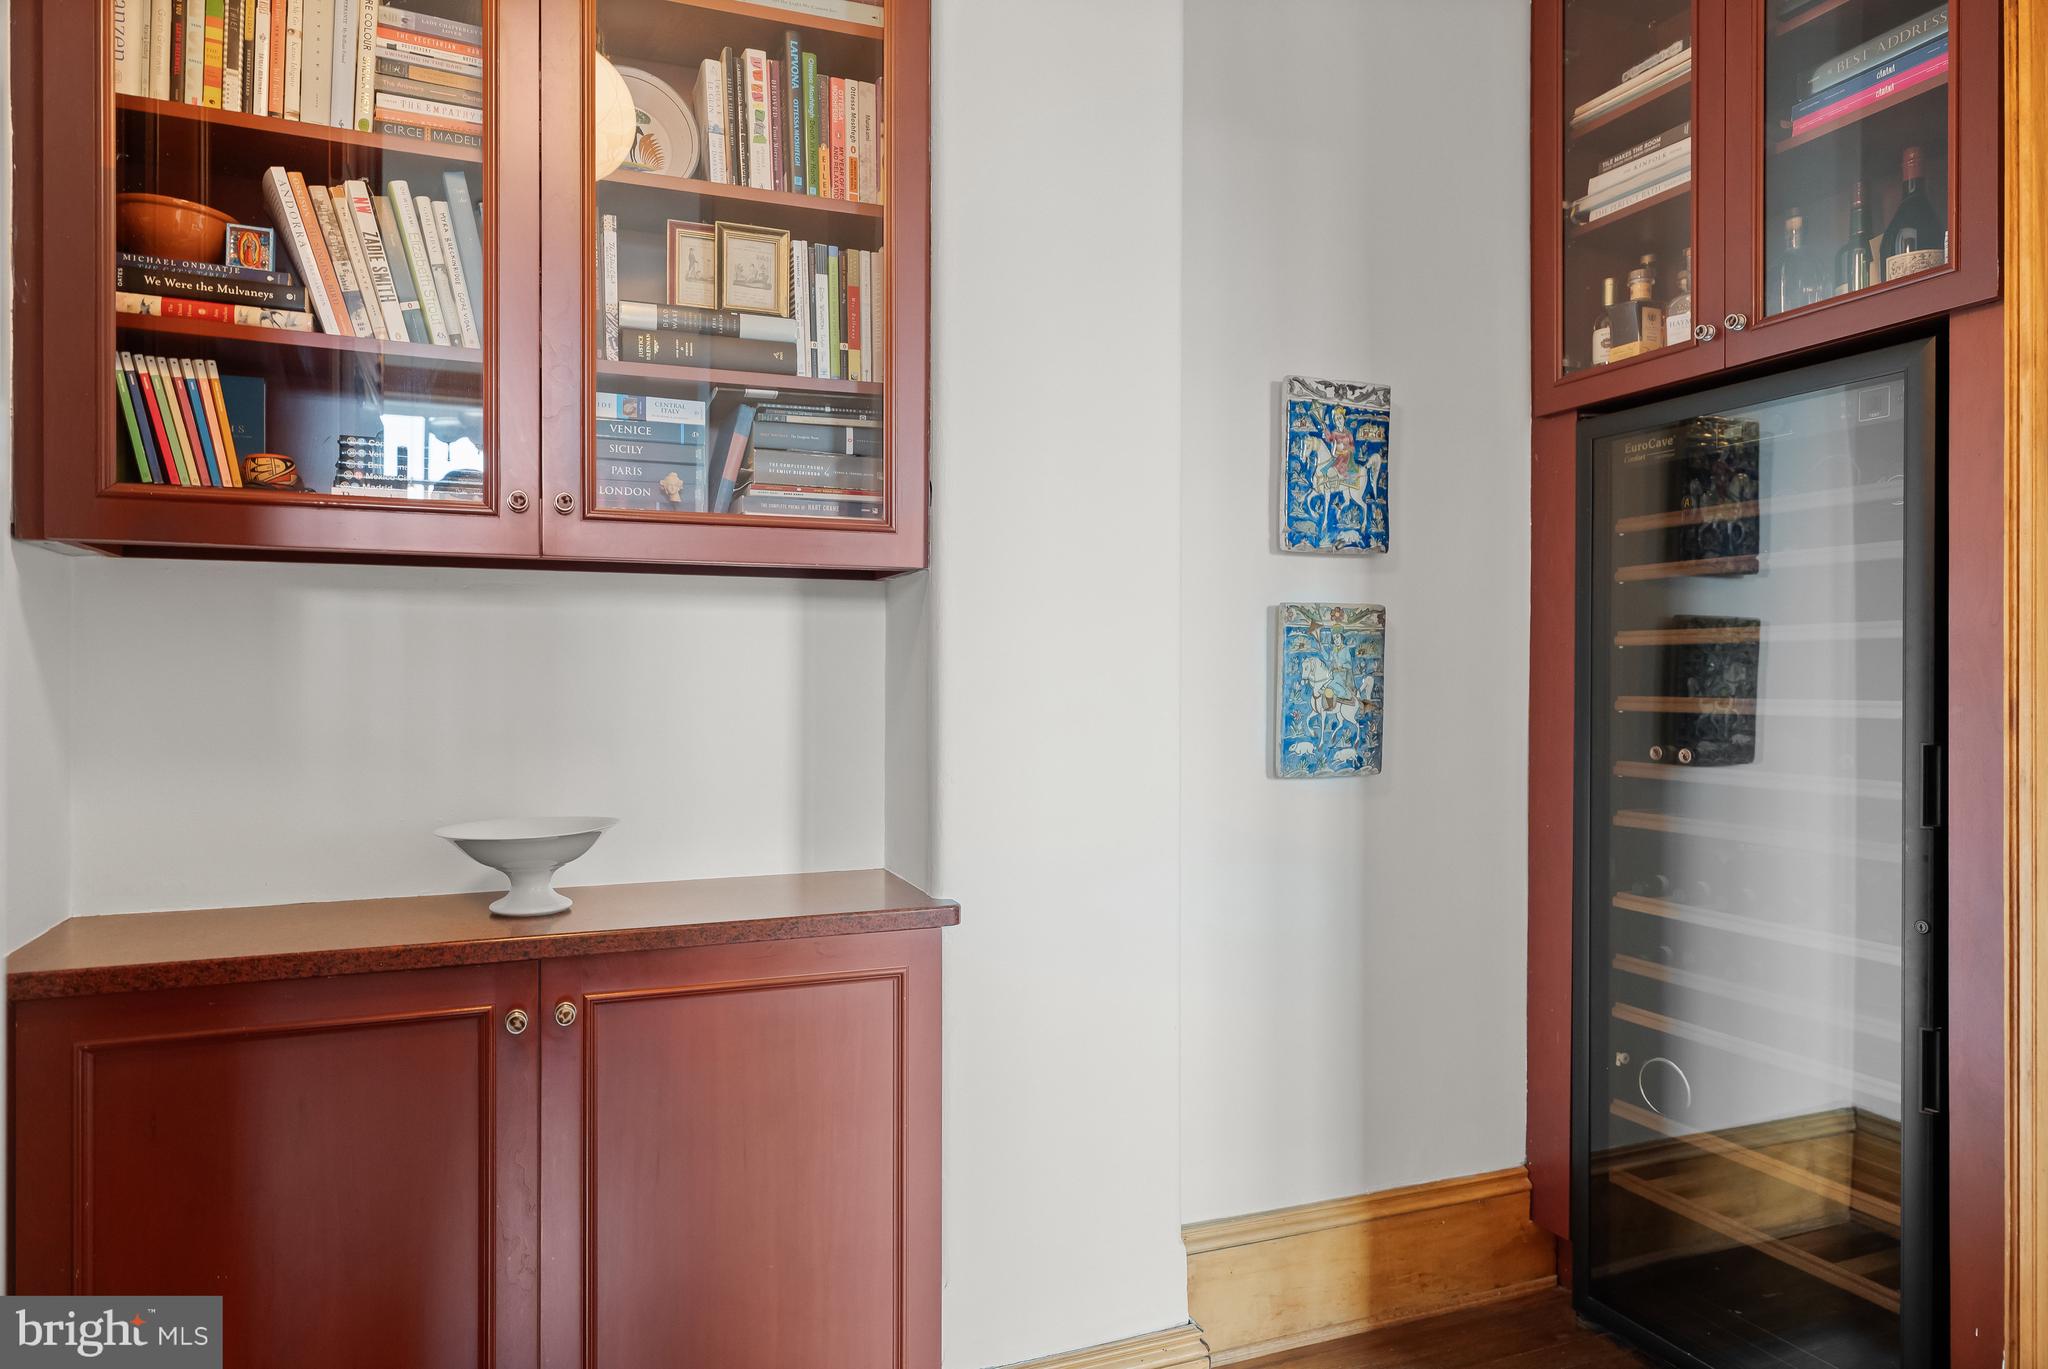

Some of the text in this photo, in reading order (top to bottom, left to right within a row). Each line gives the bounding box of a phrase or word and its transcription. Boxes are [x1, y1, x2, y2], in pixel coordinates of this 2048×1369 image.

[230, 7, 239, 32] THIEF
[363, 13, 373, 51] COLOUR
[396, 32, 409, 40] THE
[414, 36, 456, 49] VEGETARIAN
[790, 40, 800, 90] LAPVONA
[1836, 49, 1869, 73] BEST
[361, 56, 371, 89] SHEILA
[426, 102, 475, 119] EMPATHY
[384, 124, 481, 146] CIRCE MADELI
[849, 112, 857, 143] Moshfegh
[793, 132, 801, 167] MOSHFEGH
[839, 146, 844, 156] MY
[1602, 137, 1661, 168] TILE MAKES THE ROOM
[839, 178, 844, 187] OF
[278, 179, 307, 249] ANDORRA
[353, 196, 372, 215] NW
[440, 213, 449, 233] MYRA
[122, 254, 177, 267] MICHAEL
[182, 261, 241, 274] ONDAATJE
[362, 231, 397, 304] ZADIE SMITH
[144, 275, 274, 301] We Were the Mulvaneys
[408, 232, 443, 326] Elizabeth Strout
[457, 292, 472, 333] GORE VIDAL
[655, 401, 687, 410] CENTRAL
[610, 424, 653, 436] VENICE
[609, 444, 644, 455] SICILY
[1625, 436, 1674, 454] EuroCave
[611, 466, 643, 476] PARIS
[599, 486, 651, 497] LONDON
